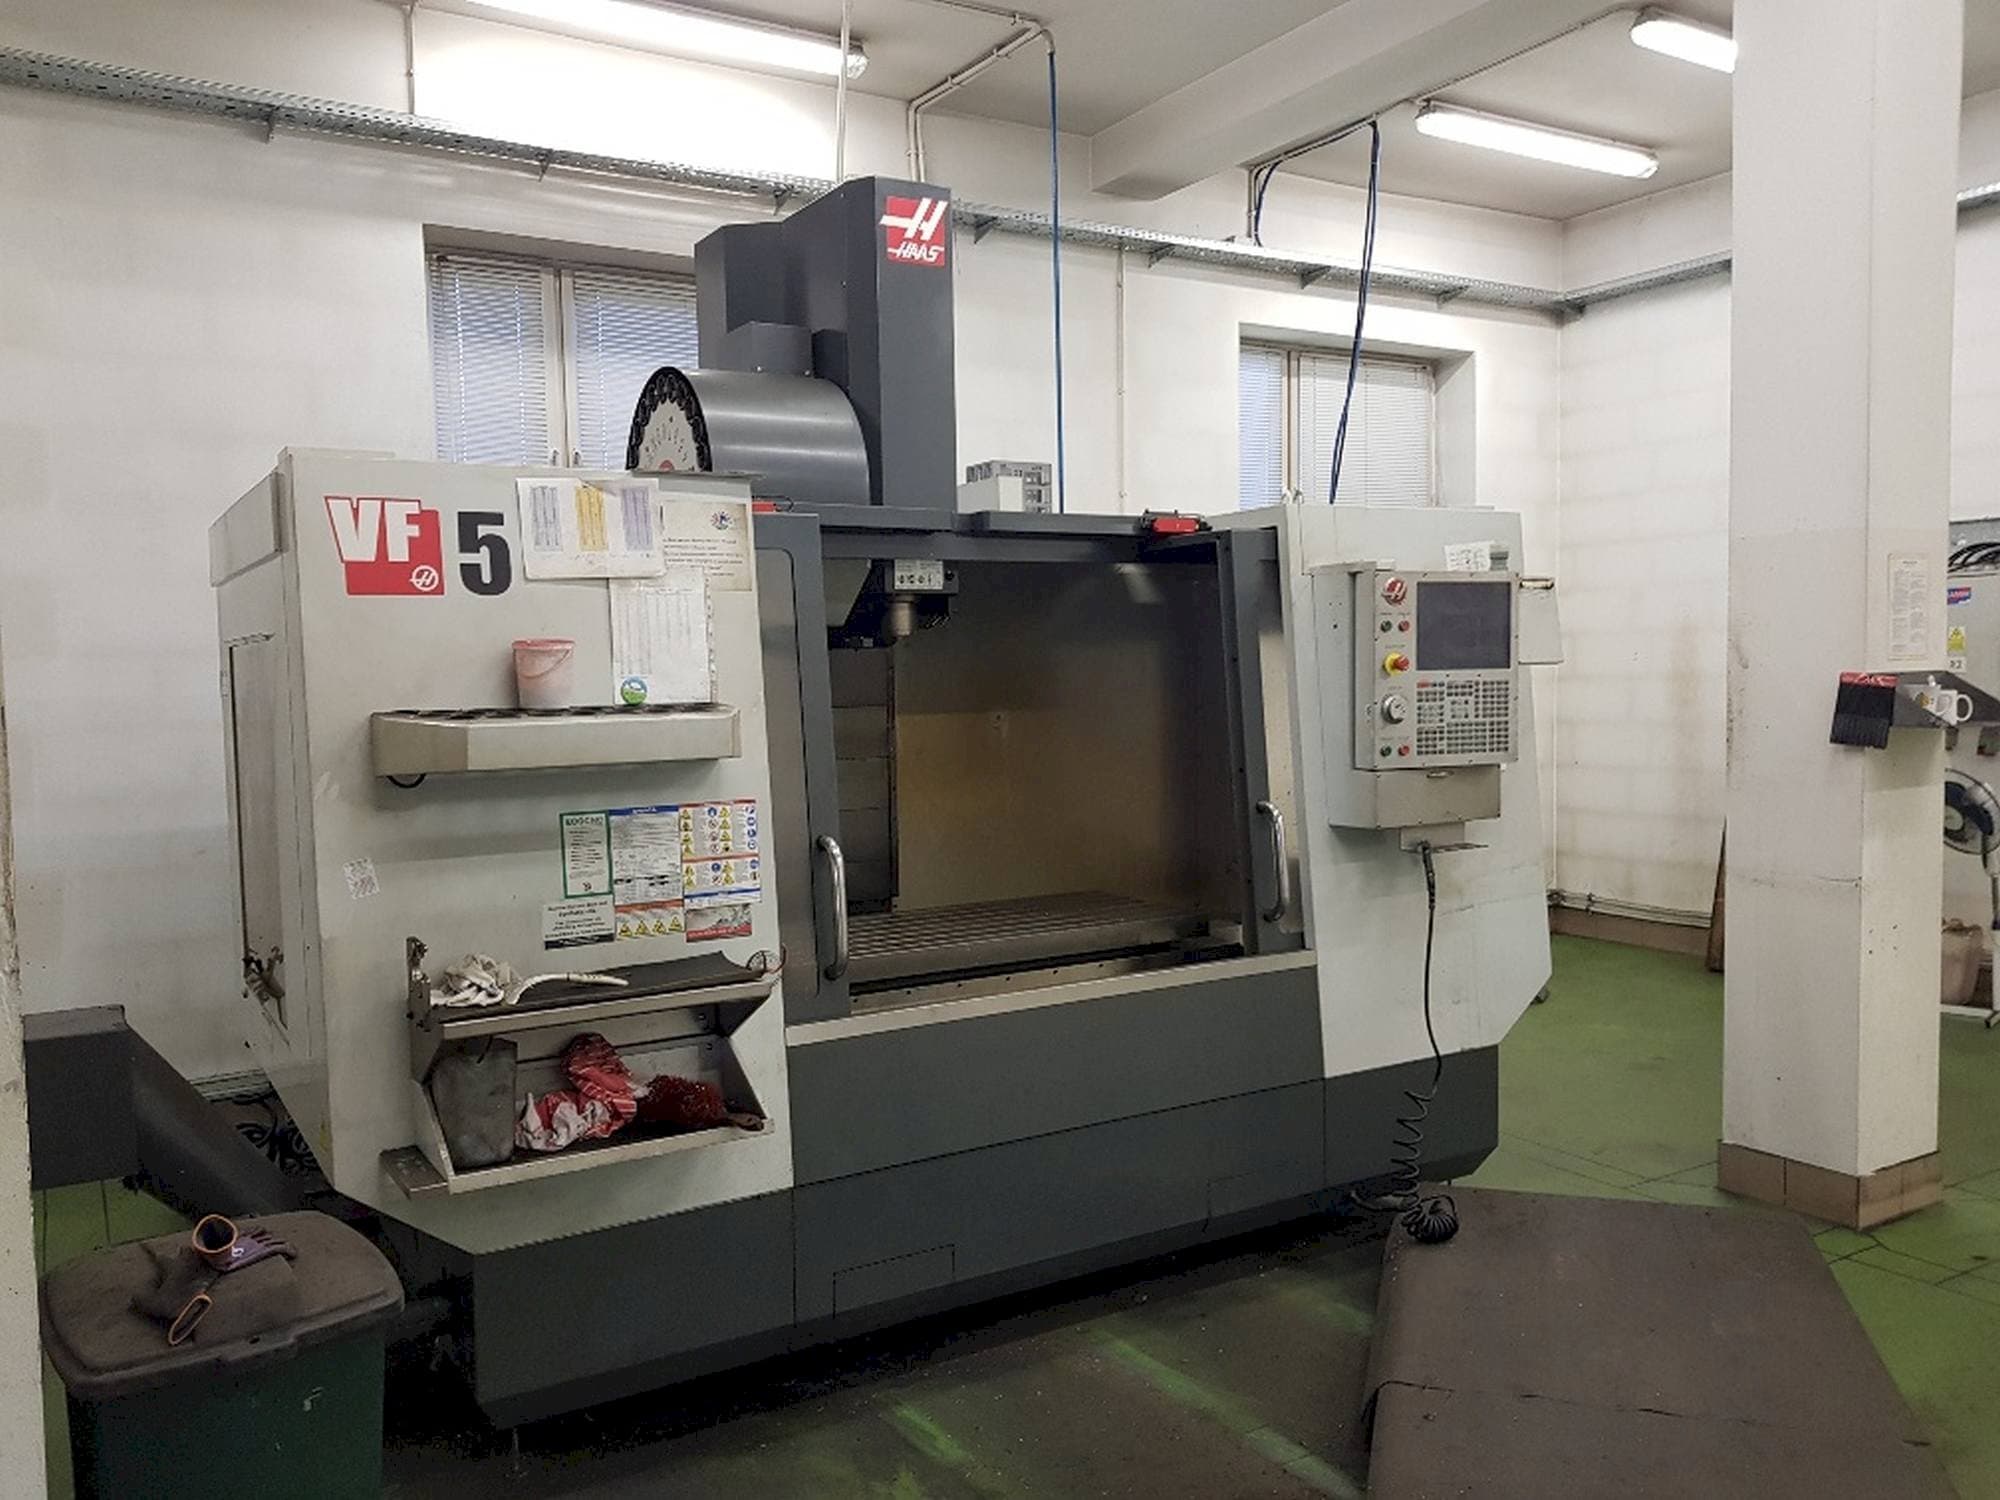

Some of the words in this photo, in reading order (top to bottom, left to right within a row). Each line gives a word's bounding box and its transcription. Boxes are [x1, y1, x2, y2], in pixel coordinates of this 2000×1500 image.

[887, 241, 945, 263] HAAS
[325, 497, 421, 563] VF
[457, 511, 512, 596] 5
